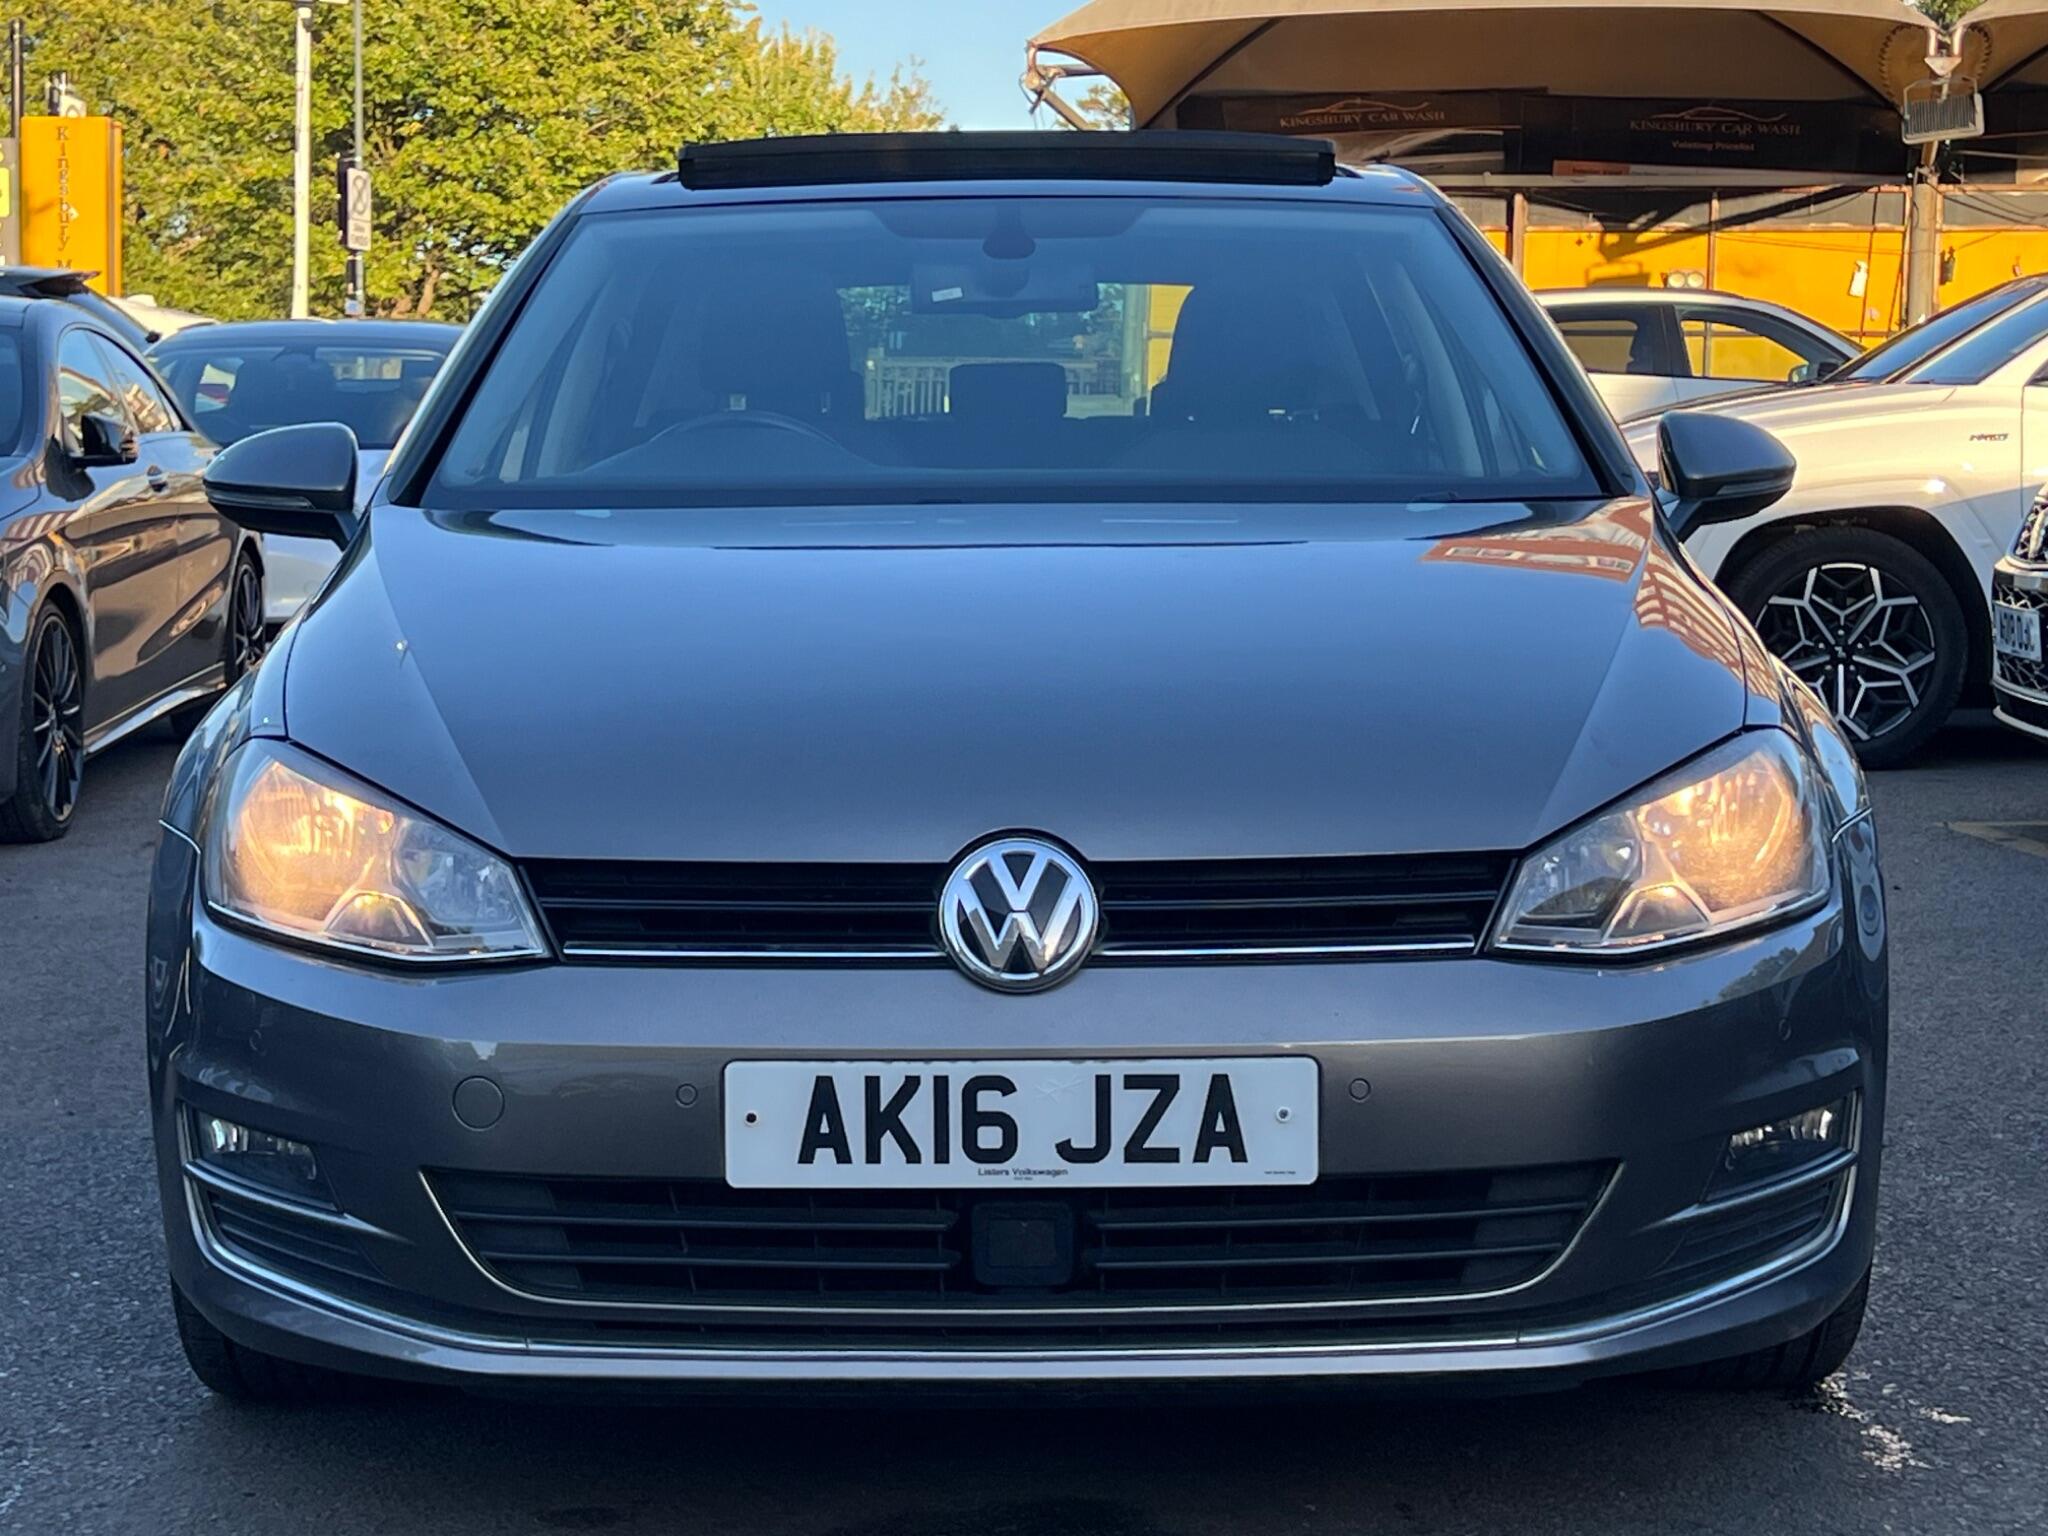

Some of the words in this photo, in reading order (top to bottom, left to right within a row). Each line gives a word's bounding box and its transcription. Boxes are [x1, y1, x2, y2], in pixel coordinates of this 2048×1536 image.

[1280, 113, 1361, 128] KINGSBURY
[1368, 112, 1398, 123] CAR
[1402, 111, 1446, 122] WASH
[1629, 119, 1715, 133] KINGSBURY
[1721, 122, 1753, 134] CAR
[1757, 123, 1801, 135] WASH
[797, 1075, 1018, 1164] AK16
[1055, 1074, 1248, 1163] JZA
[1011, 1167, 1068, 1178] Volkswagen
